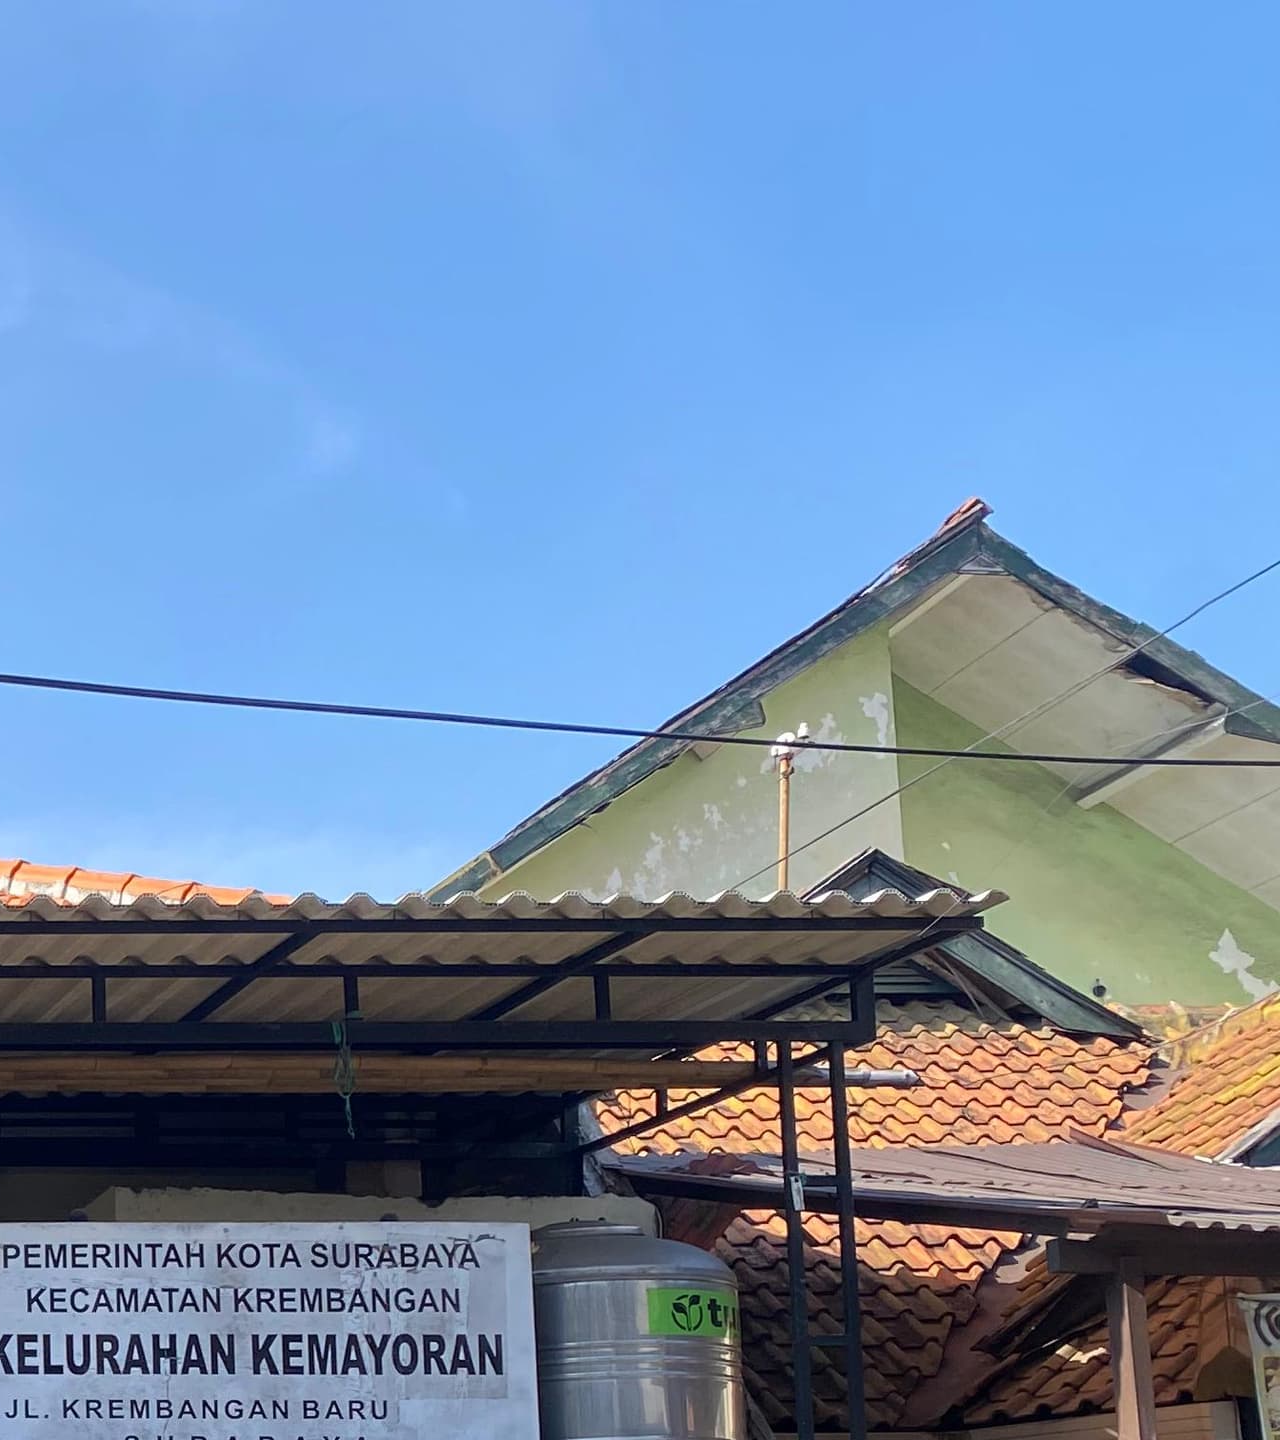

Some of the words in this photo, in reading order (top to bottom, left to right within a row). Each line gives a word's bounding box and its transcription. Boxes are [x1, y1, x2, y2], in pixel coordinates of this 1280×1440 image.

[2, 1244, 204, 1269] PEMERINTAH
[216, 1244, 302, 1269] KOTA
[310, 1243, 480, 1268] SURABAYA
[26, 1288, 221, 1314] KECAMATAN
[233, 1288, 460, 1314] KREMBANGAN
[250, 1333, 504, 1376] KEMAYORAN
[4, 1400, 50, 1419] JL.
[62, 1400, 291, 1420] KREMBANGAN
[302, 1400, 389, 1420] BARU
